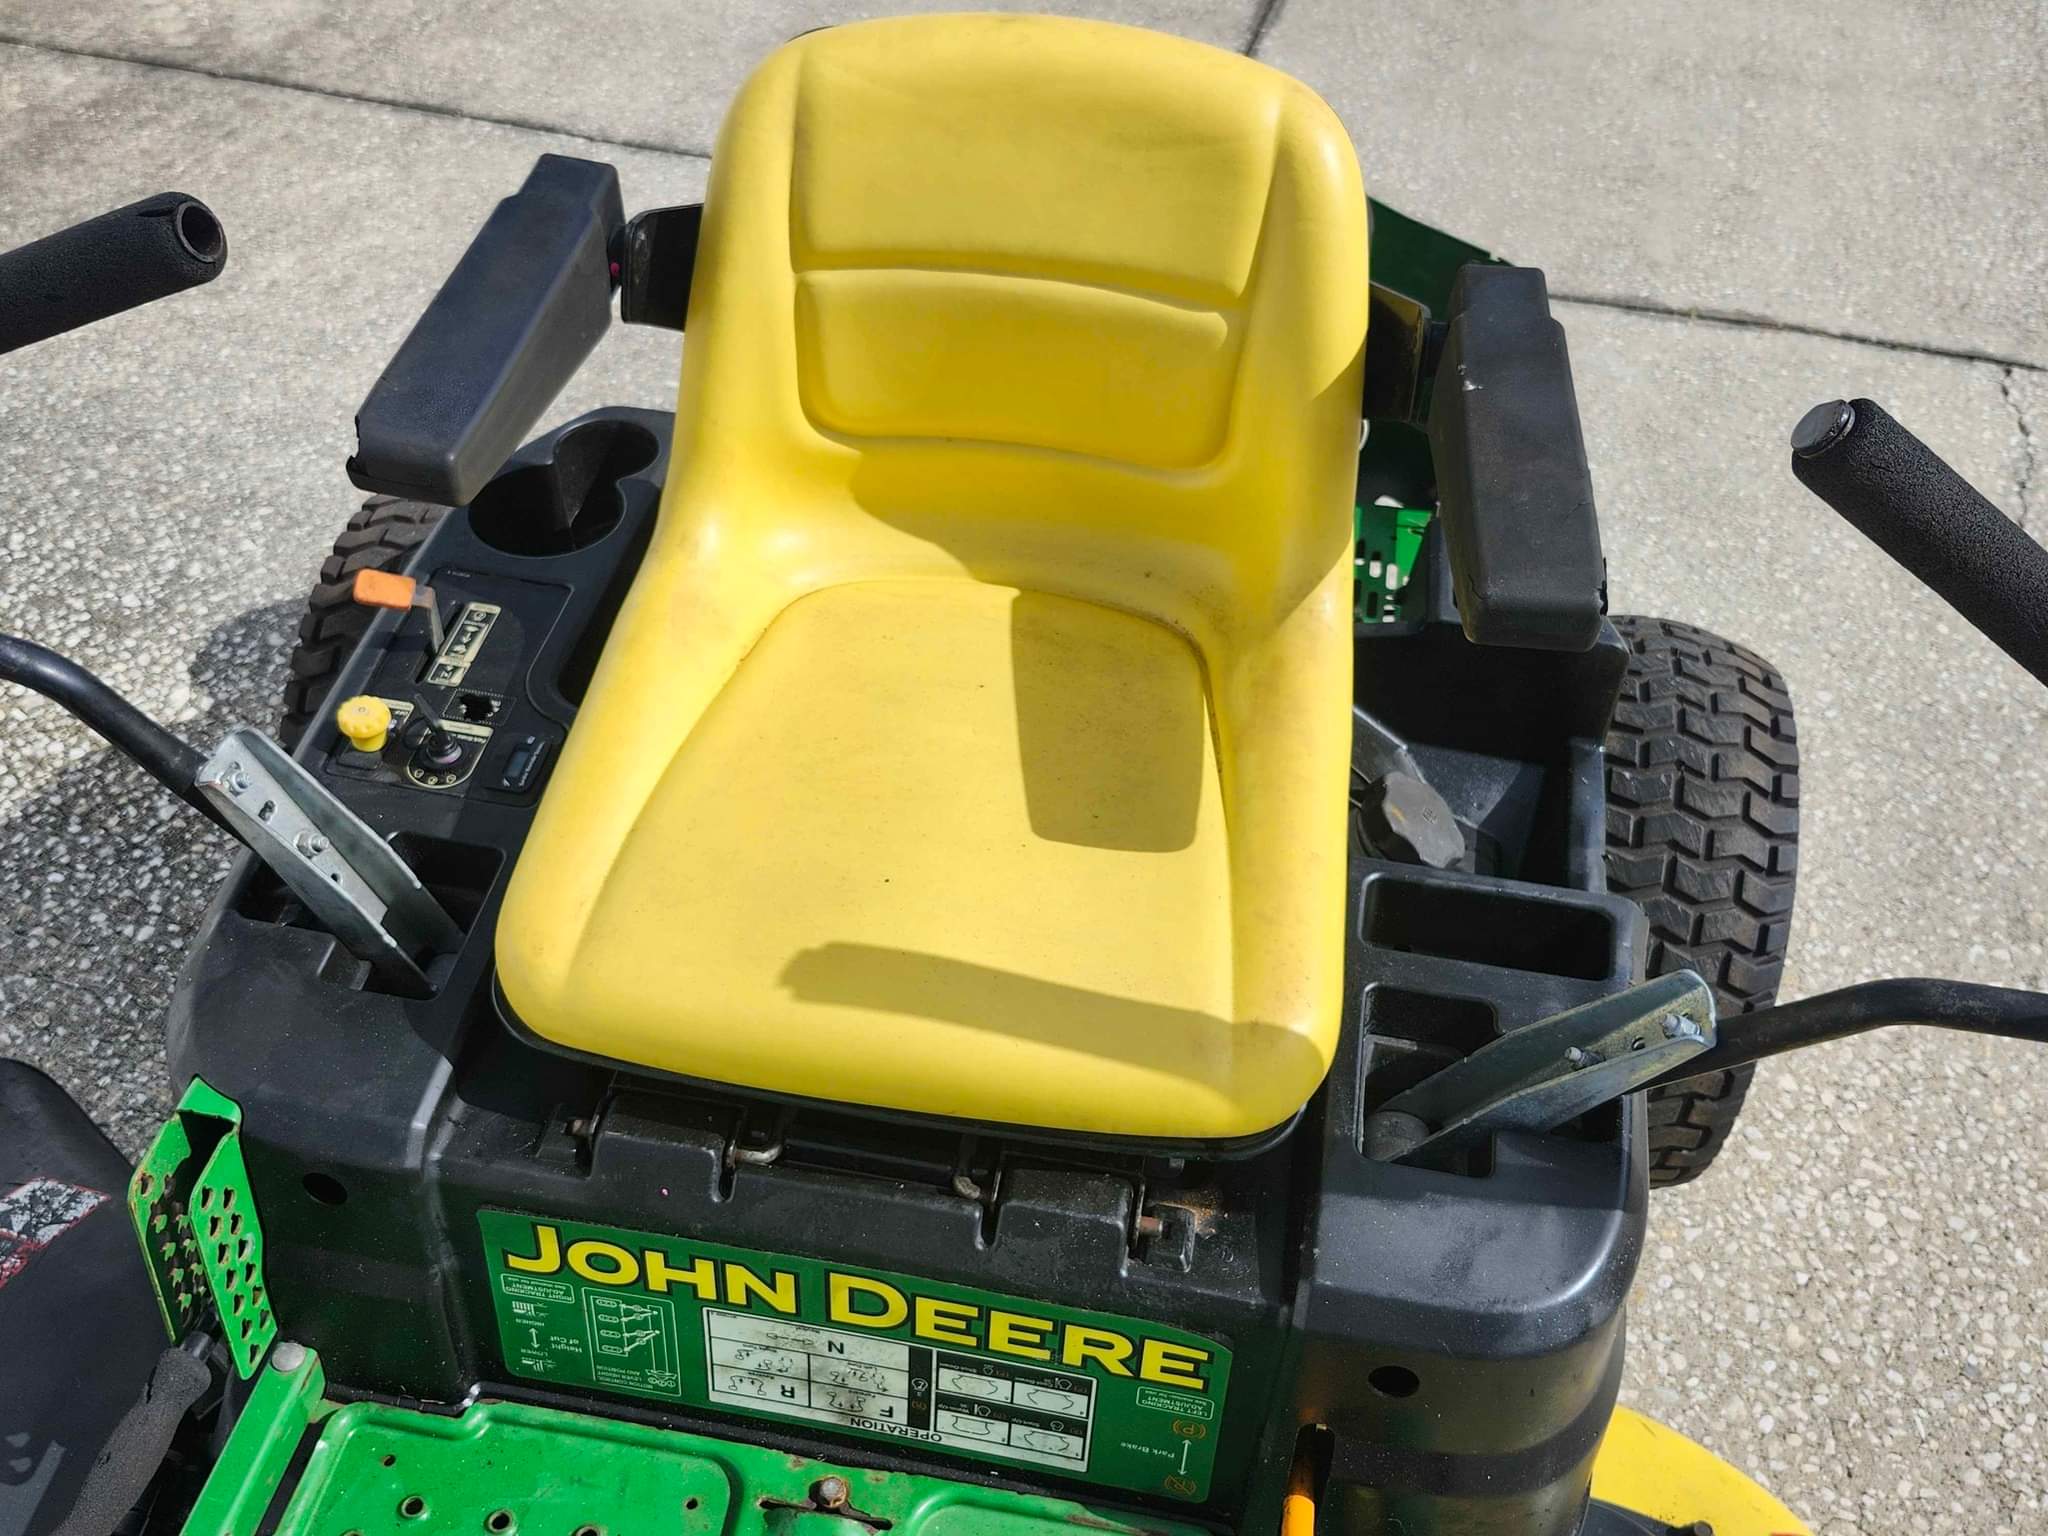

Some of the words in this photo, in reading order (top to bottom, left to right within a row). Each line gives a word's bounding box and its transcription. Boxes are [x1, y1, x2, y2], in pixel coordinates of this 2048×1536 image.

[512, 1283, 564, 1295] ADJUSTMENT
[505, 1225, 797, 1315] JOHN
[829, 1272, 1209, 1390] DEERE
[521, 1348, 548, 1356] LOWER
[551, 1343, 582, 1353] Height
[827, 1341, 845, 1355] N
[780, 1385, 795, 1398] R
[1141, 1399, 1184, 1412] TRACKING
[1147, 1395, 1204, 1410] ADJUSTMENT
[879, 1406, 894, 1418] F
[1186, 1408, 1208, 1417] LEFT
[850, 1417, 942, 1442] OPERATION
[1120, 1442, 1150, 1453] Brake
[1152, 1447, 1175, 1458] Park
